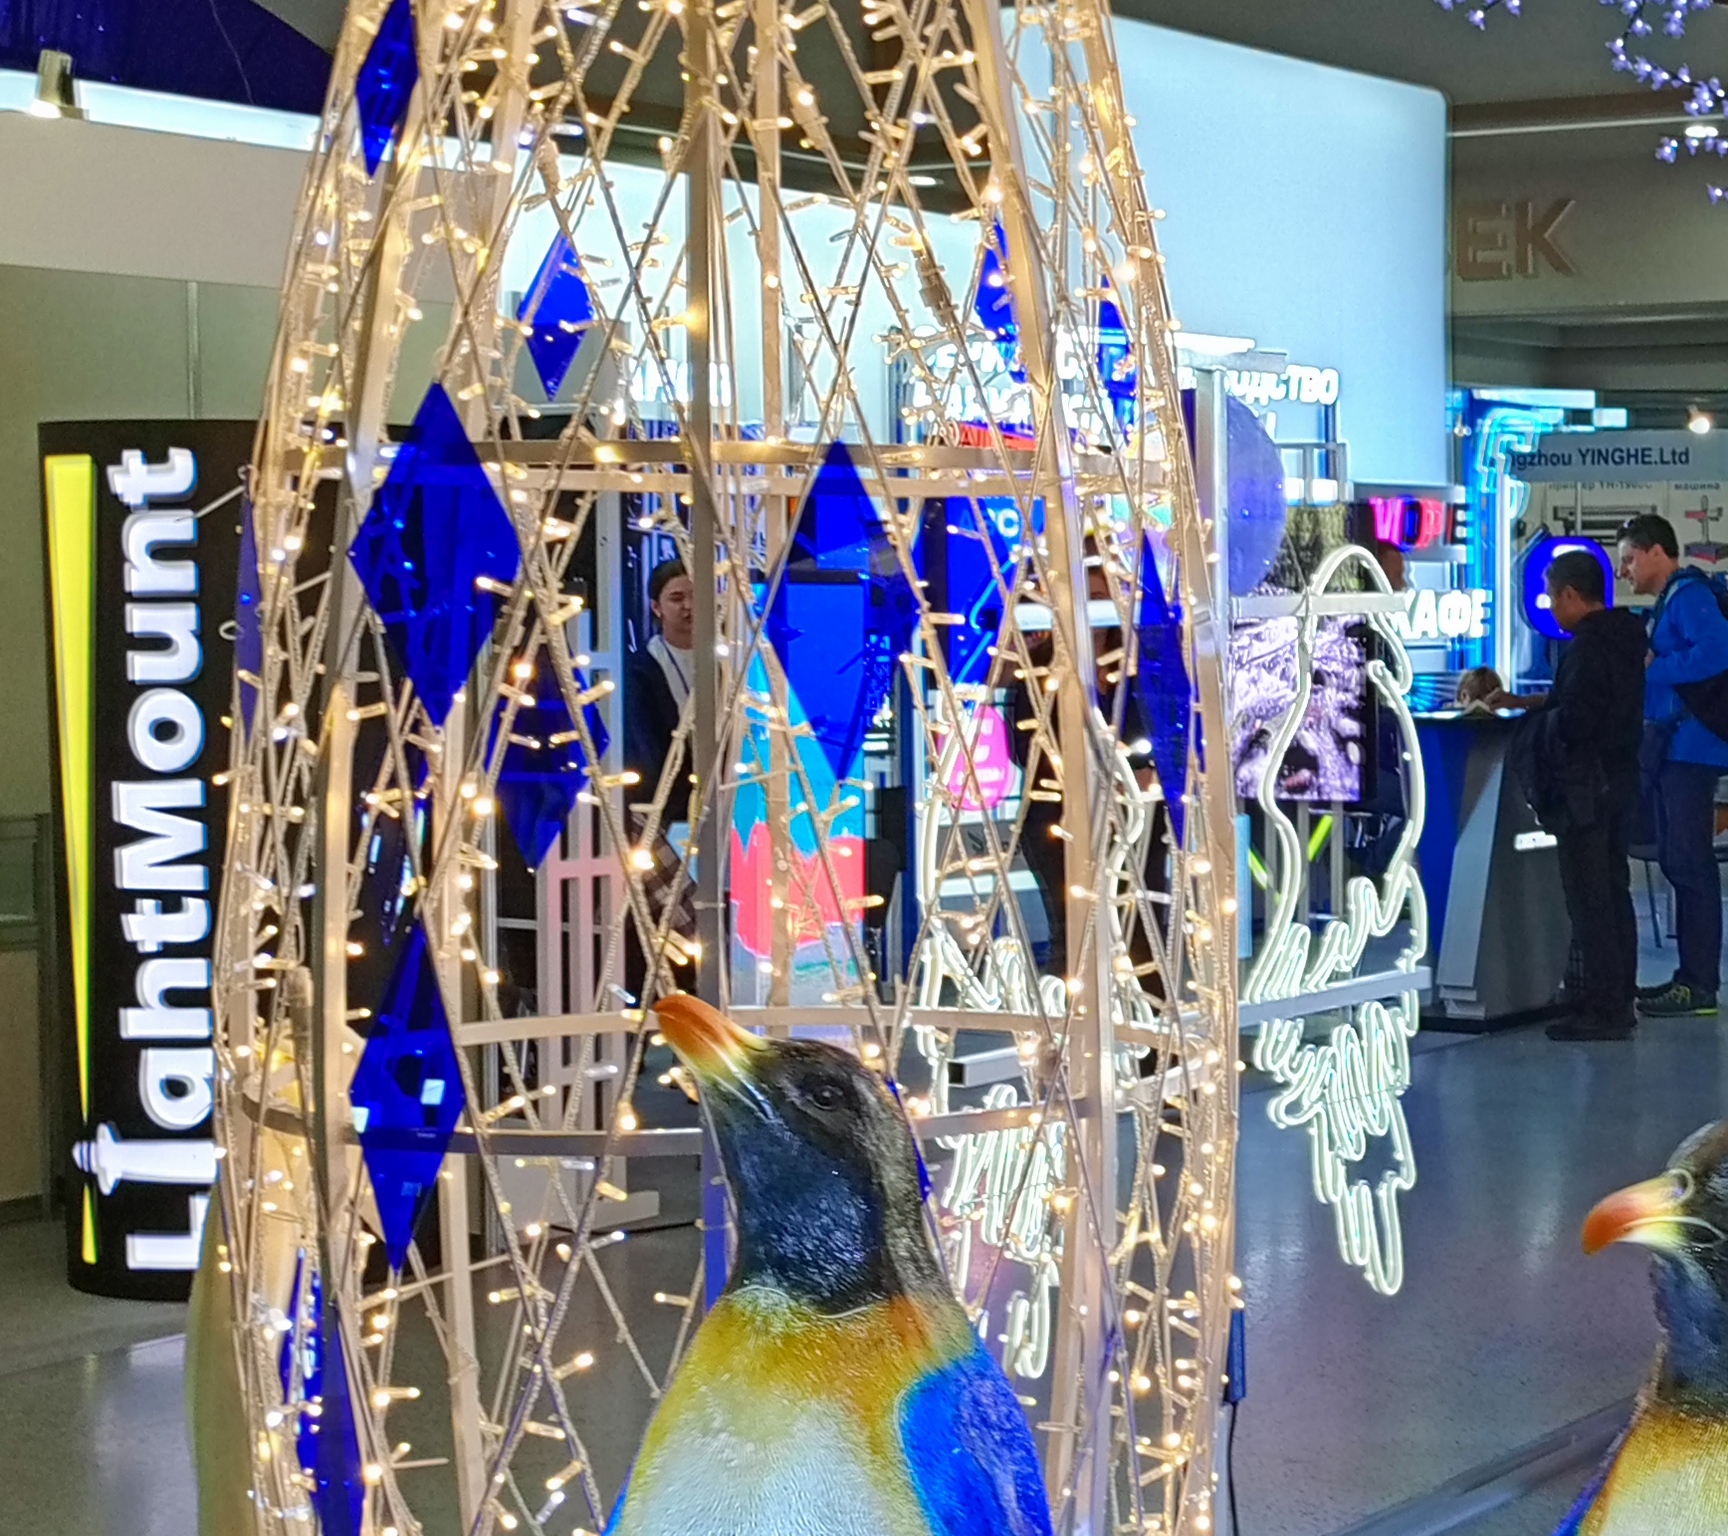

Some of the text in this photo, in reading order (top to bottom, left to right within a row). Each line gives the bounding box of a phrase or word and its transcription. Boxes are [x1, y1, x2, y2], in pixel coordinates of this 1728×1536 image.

[1507, 446, 1691, 471] ngzhou YINGHE.Ltd
[1387, 588, 1488, 639] КАФЕ
